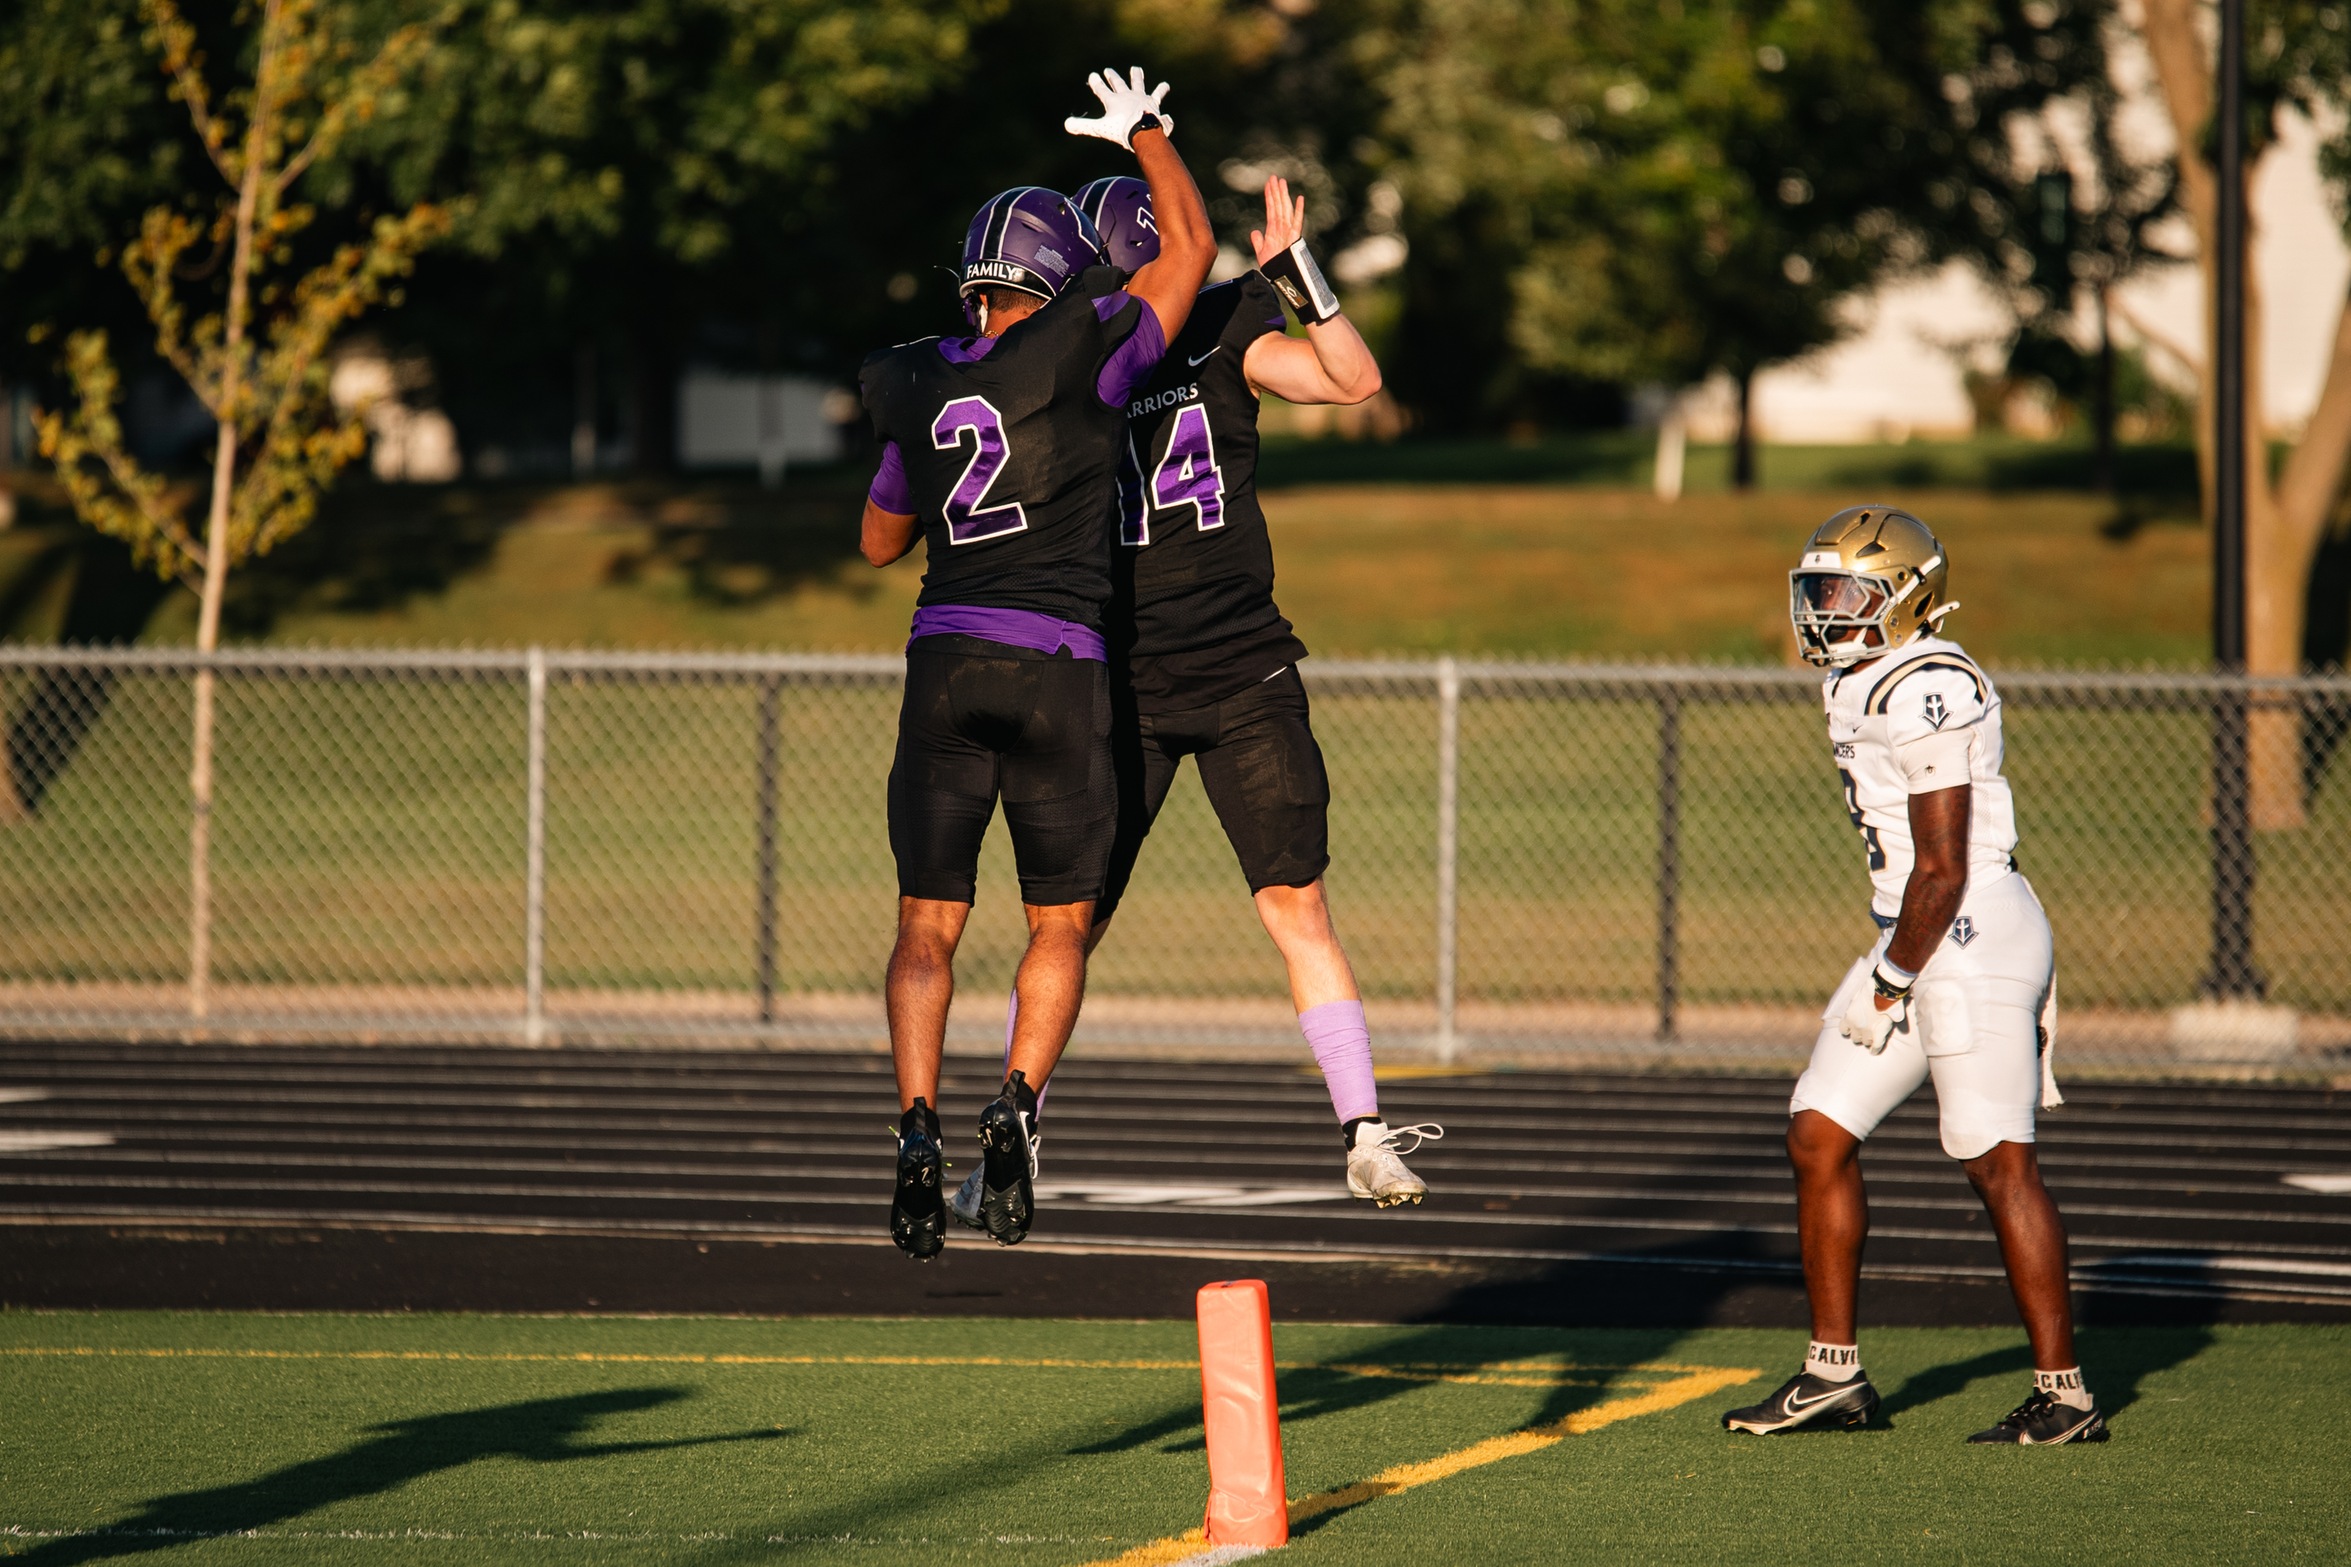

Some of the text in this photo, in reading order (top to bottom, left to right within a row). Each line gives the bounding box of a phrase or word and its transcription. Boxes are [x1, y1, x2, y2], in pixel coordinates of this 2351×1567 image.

[966, 262, 1015, 281] FAMILY
[1127, 382, 1199, 419] RRIORS
[931, 394, 1029, 546] 2
